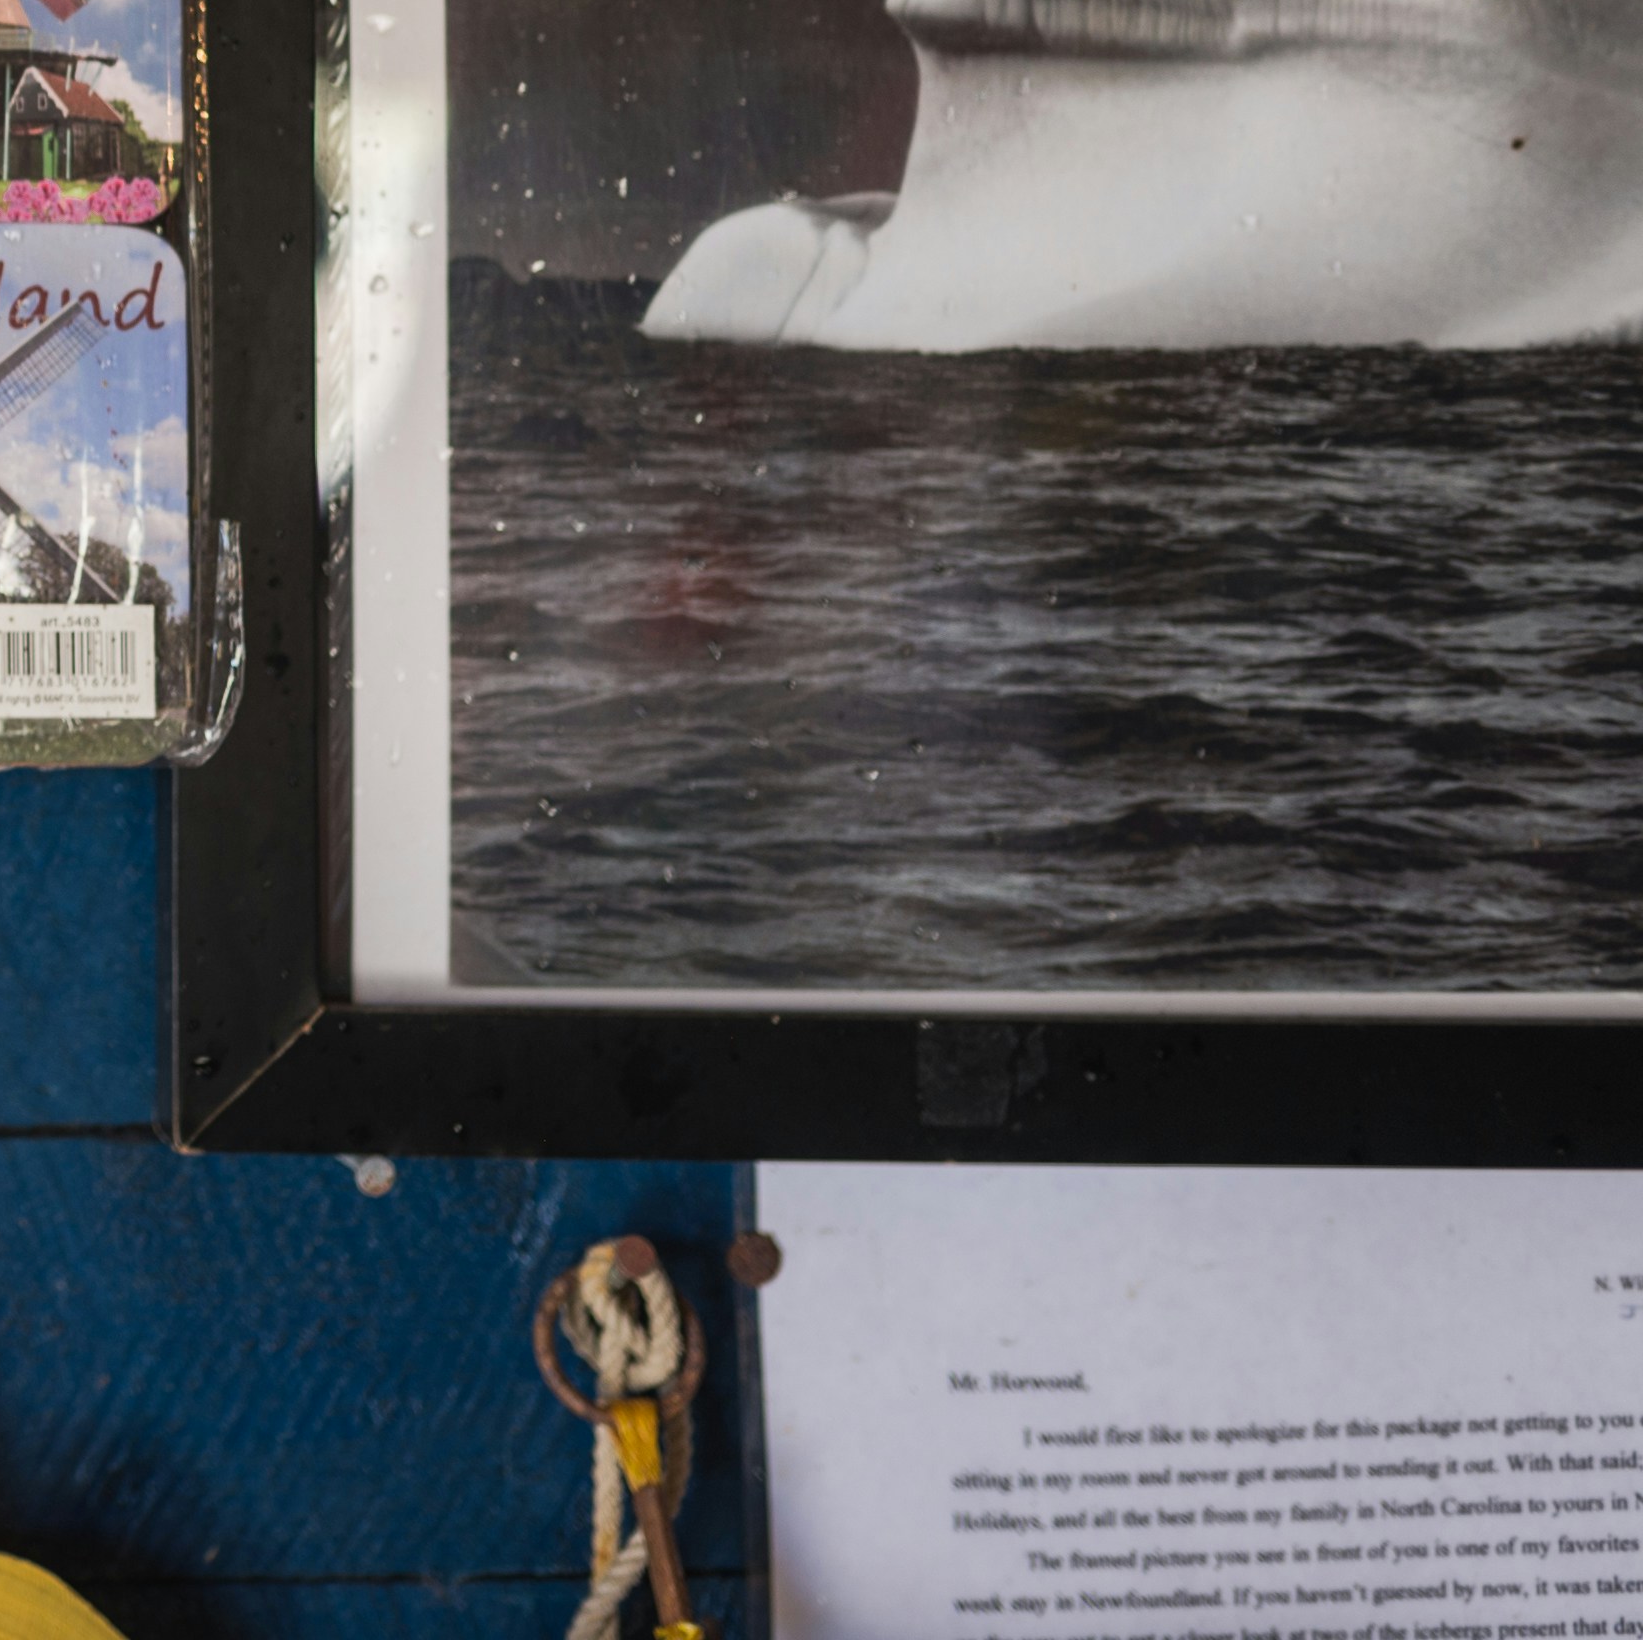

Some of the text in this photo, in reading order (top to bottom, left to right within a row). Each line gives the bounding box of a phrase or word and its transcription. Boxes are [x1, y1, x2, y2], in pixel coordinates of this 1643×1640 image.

[1346, 1417, 1379, 1437] this
[1385, 1416, 1461, 1441] package
[1468, 1417, 1497, 1433] not
[1504, 1413, 1569, 1437] getting
[1575, 1414, 1593, 1429] to
[1599, 1414, 1634, 1434] you
[1344, 1464, 1361, 1479] to
[1368, 1458, 1439, 1481] sending
[1447, 1457, 1457, 1474] it
[1464, 1460, 1497, 1474] out.
[1507, 1453, 1554, 1473] With
[1559, 1453, 1594, 1471] that
[1291, 1501, 1349, 1525] family
[1358, 1498, 1374, 1519] in
[1381, 1497, 1434, 1517] North
[1441, 1495, 1521, 1516] Carolina
[1529, 1495, 1546, 1513] to
[1552, 1494, 1604, 1518] yours
[1611, 1491, 1628, 1509] in
[1317, 1543, 1362, 1561] front
[1368, 1540, 1389, 1560] of
[1394, 1543, 1428, 1564] you
[1435, 1540, 1450, 1558] is
[1456, 1541, 1489, 1558] one
[1496, 1536, 1517, 1556] of
[1522, 1539, 1550, 1560] my
[1559, 1533, 1640, 1555] favorites
[1297, 1583, 1366, 1604] haven't
[1373, 1580, 1447, 1607] guessed
[1453, 1579, 1474, 1604] by
[1483, 1583, 1529, 1600] now,
[1536, 1577, 1548, 1596] it
[1556, 1580, 1591, 1596] was
[1597, 1576, 1643, 1595] taken
[1414, 1620, 1492, 1640] icebergs
[1498, 1619, 1567, 1640] present
[1573, 1617, 1608, 1637] that
